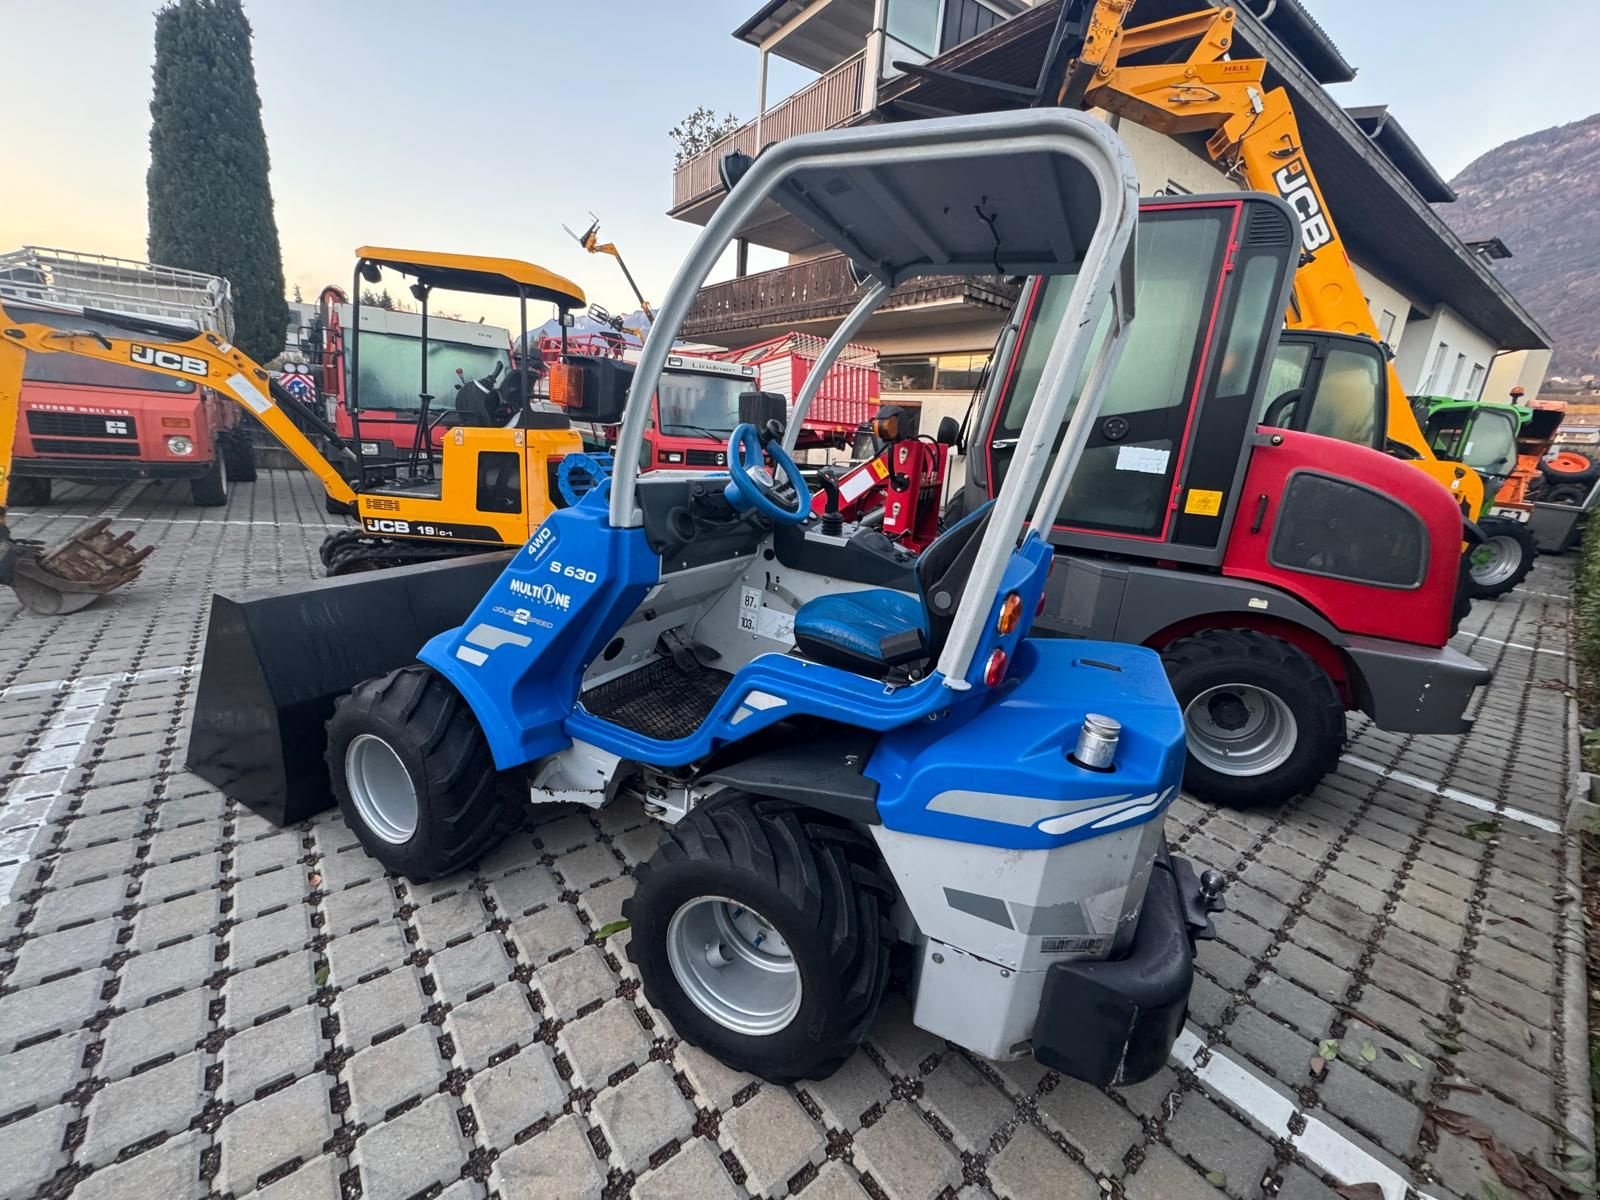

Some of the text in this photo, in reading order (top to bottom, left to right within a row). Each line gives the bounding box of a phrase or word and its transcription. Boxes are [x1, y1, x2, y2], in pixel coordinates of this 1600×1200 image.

[1276, 166, 1331, 251] JCB
[131, 346, 208, 376] JCB
[367, 519, 410, 533] JCB
[417, 525, 435, 535] 19
[528, 527, 551, 555] 4WD
[549, 560, 597, 584] S 630
[744, 595, 755, 607] 87
[740, 616, 753, 630] 103
